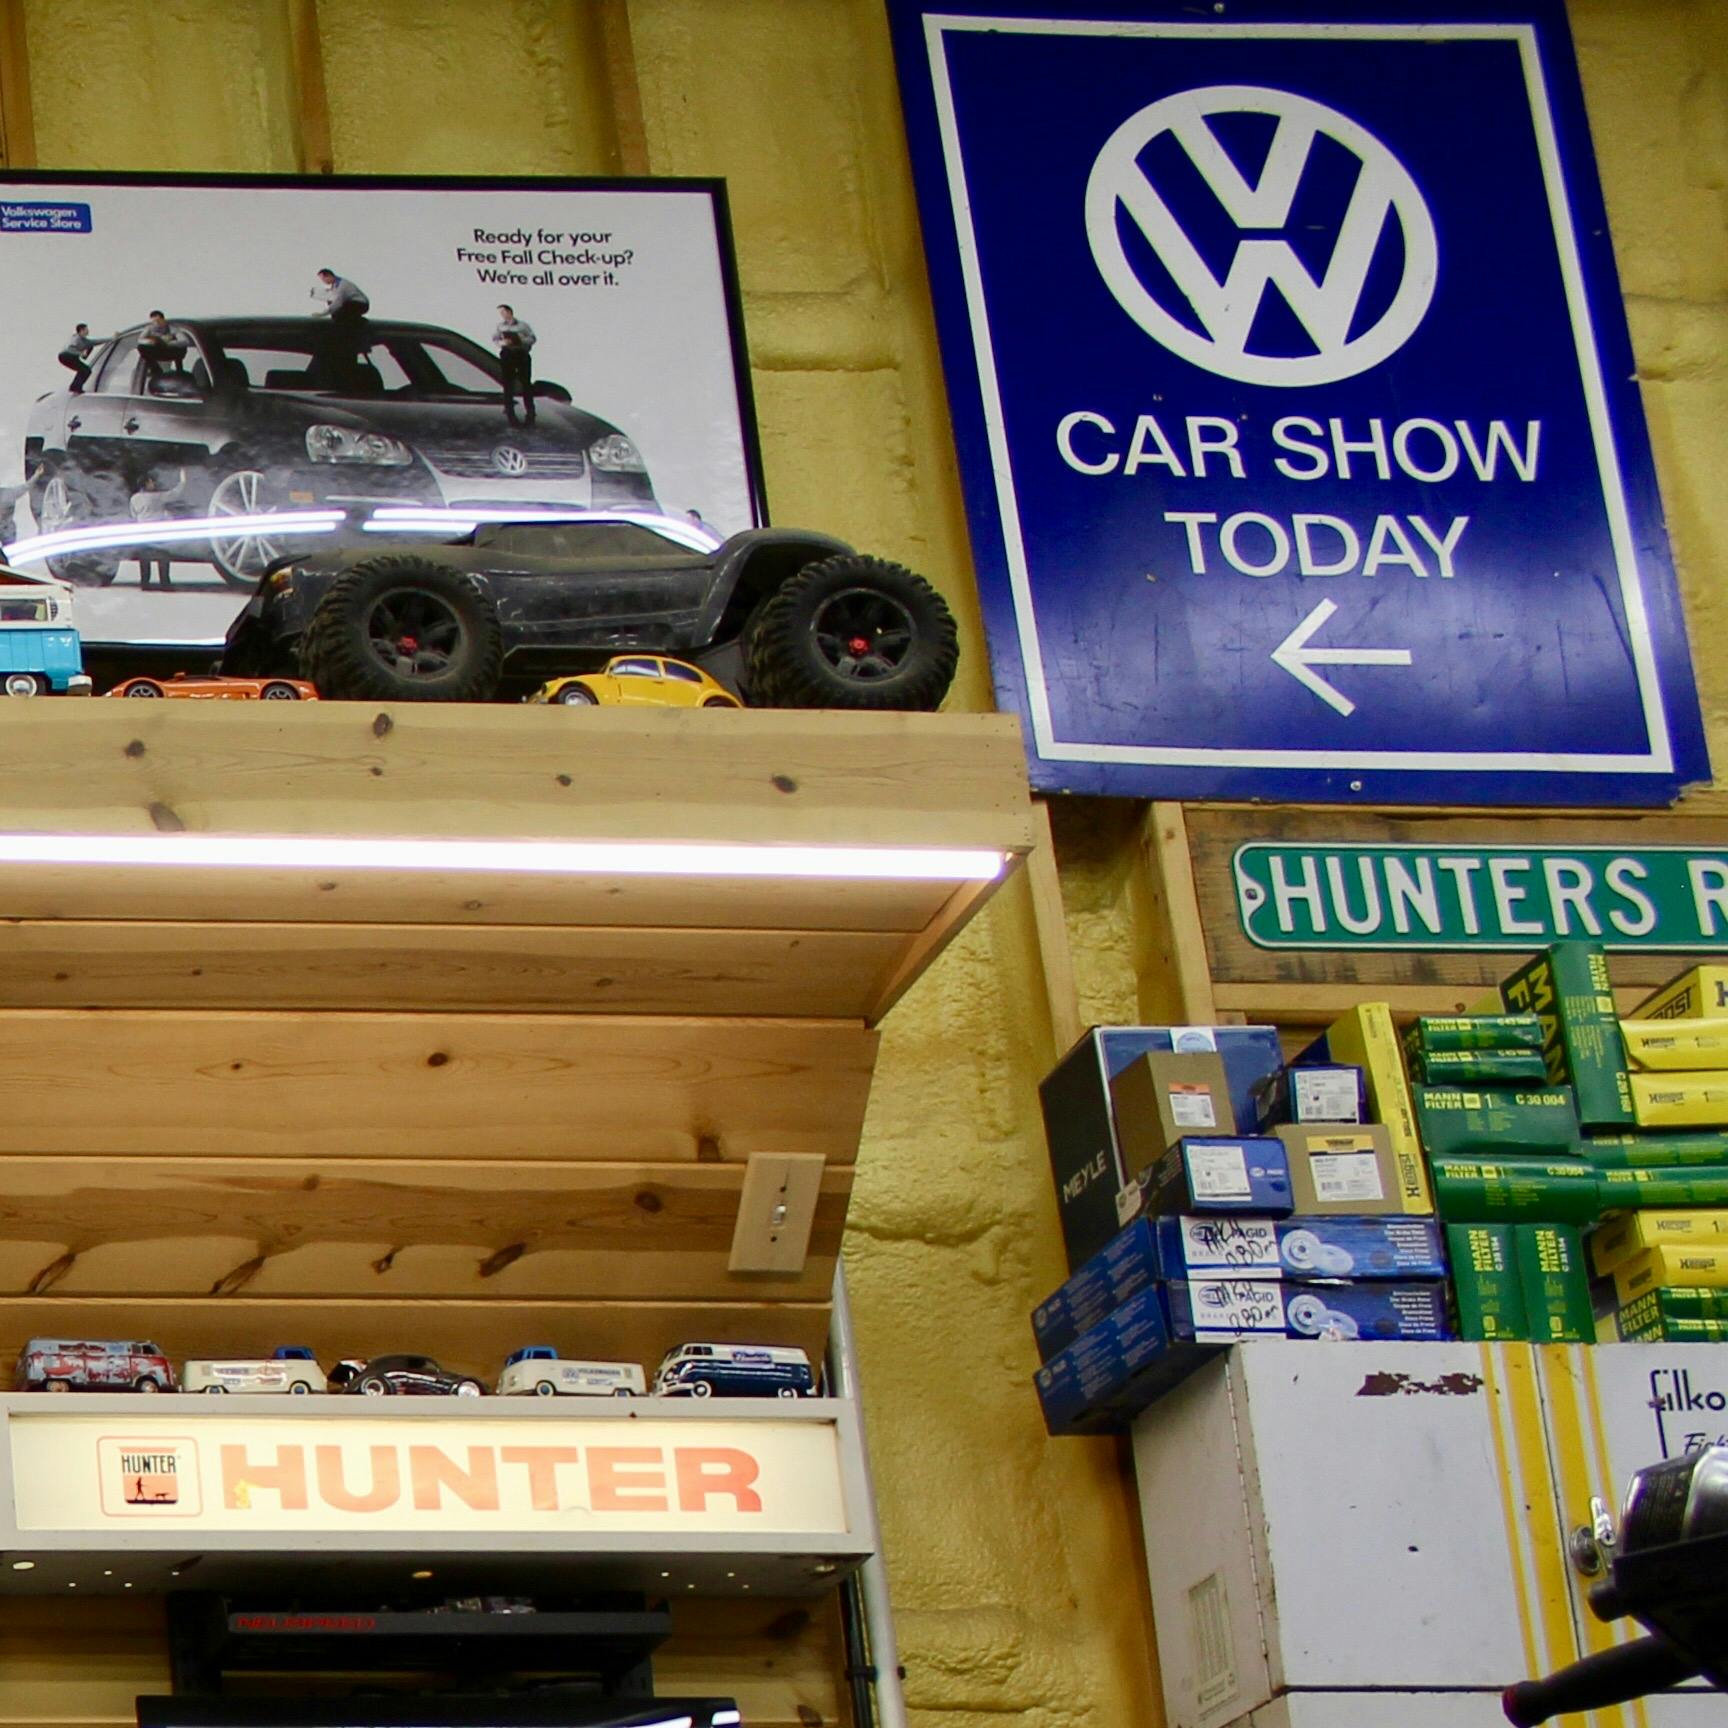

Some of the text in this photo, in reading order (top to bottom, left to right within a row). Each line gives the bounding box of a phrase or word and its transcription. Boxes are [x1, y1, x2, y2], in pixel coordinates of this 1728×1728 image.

[0, 205, 77, 218] Volkswagen
[2, 217, 82, 229] Service Store
[473, 228, 613, 247] Ready for your
[456, 247, 635, 268] Free Fall Check-up?
[476, 268, 620, 286] We're all over it.
[1055, 411, 1542, 483] CAR SHOW
[1164, 511, 1470, 580] TODAY
[1268, 855, 1728, 937] HUNTERS R
[1423, 1092, 1462, 1101] MANN
[1424, 1100, 1463, 1110] FILTER
[1063, 1150, 1108, 1203] MEYLE
[1444, 1164, 1477, 1172] MANN
[1445, 1170, 1479, 1179] FILTER
[1468, 1230, 1484, 1272] MANN
[1478, 1229, 1495, 1272] FILTER
[1535, 1230, 1551, 1272] MANN
[1544, 1229, 1561, 1272] FILTER
[1619, 1292, 1657, 1322] MANN
[1622, 1306, 1660, 1336] FILTER
[120, 1454, 177, 1474] HUNTER
[221, 1444, 763, 1514] HUNTER
